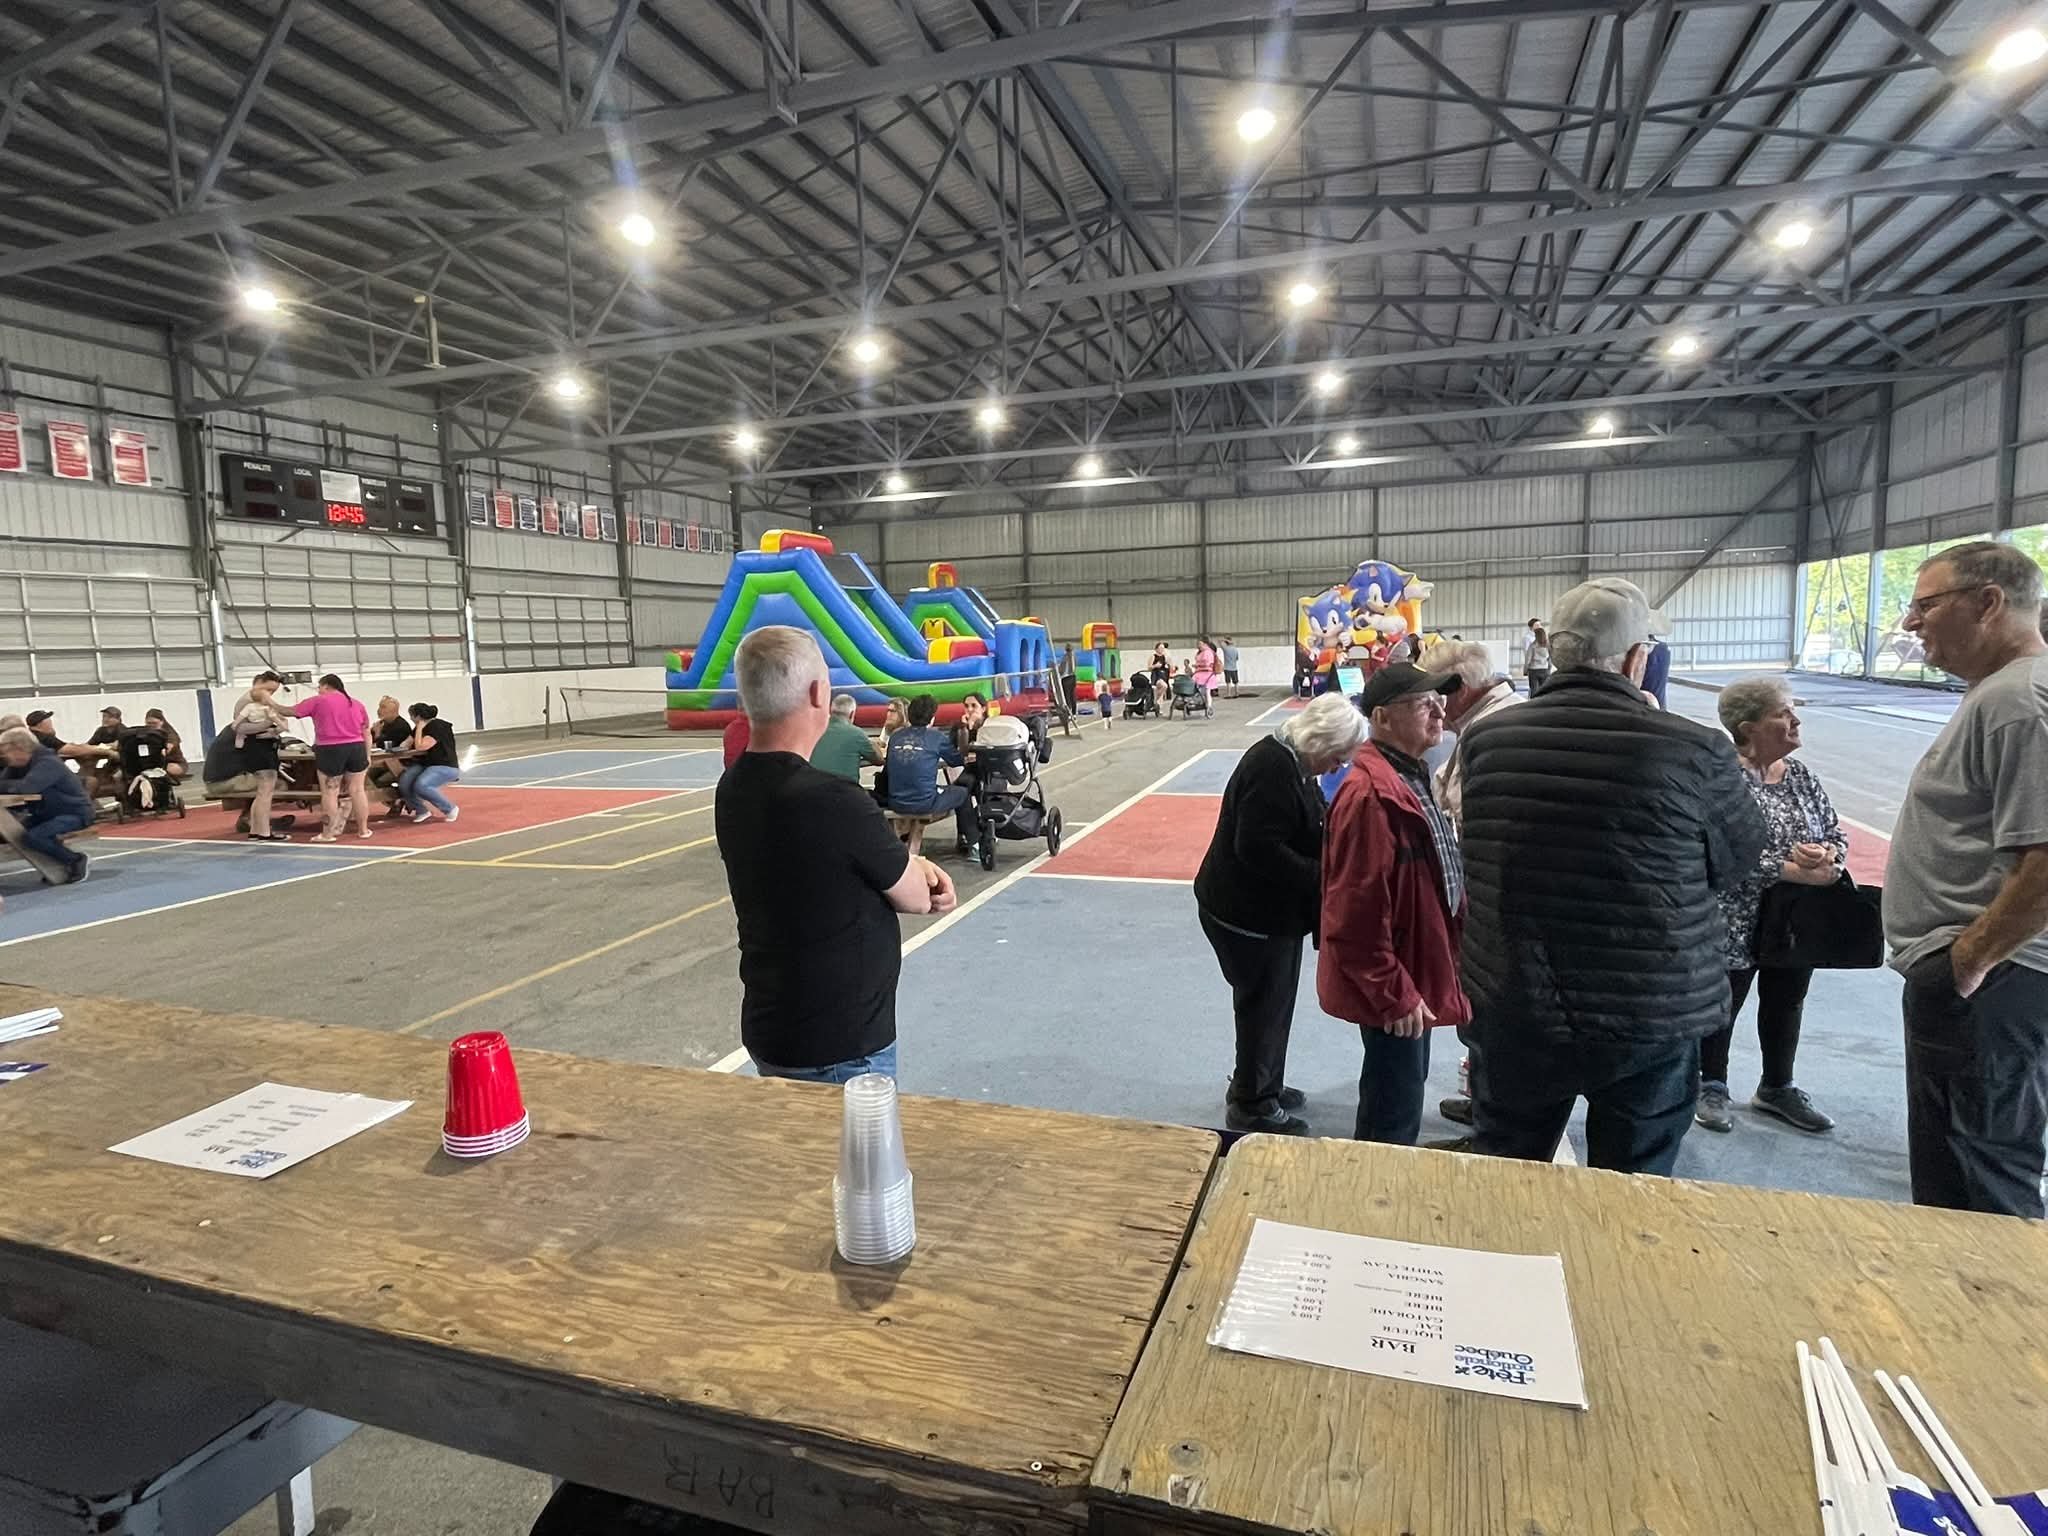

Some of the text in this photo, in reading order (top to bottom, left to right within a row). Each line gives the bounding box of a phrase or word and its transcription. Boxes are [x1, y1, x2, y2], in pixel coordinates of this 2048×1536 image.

[1362, 1260, 1398, 1270] CLAW
[1401, 1265, 1444, 1276] WHITE
[1387, 1273, 1444, 1285] SANGRIA
[1369, 1307, 1443, 1323] GATORADE
[1382, 1325, 1443, 1340] LIQUEUR
[1416, 1323, 1443, 1332] EAU
[1370, 1338, 1416, 1354] BAR
[1455, 1345, 1533, 1365] Québec
[1455, 1355, 1534, 1372] nationale
[1472, 1365, 1528, 1385] Fête
[662, 1442, 775, 1518] BAR
